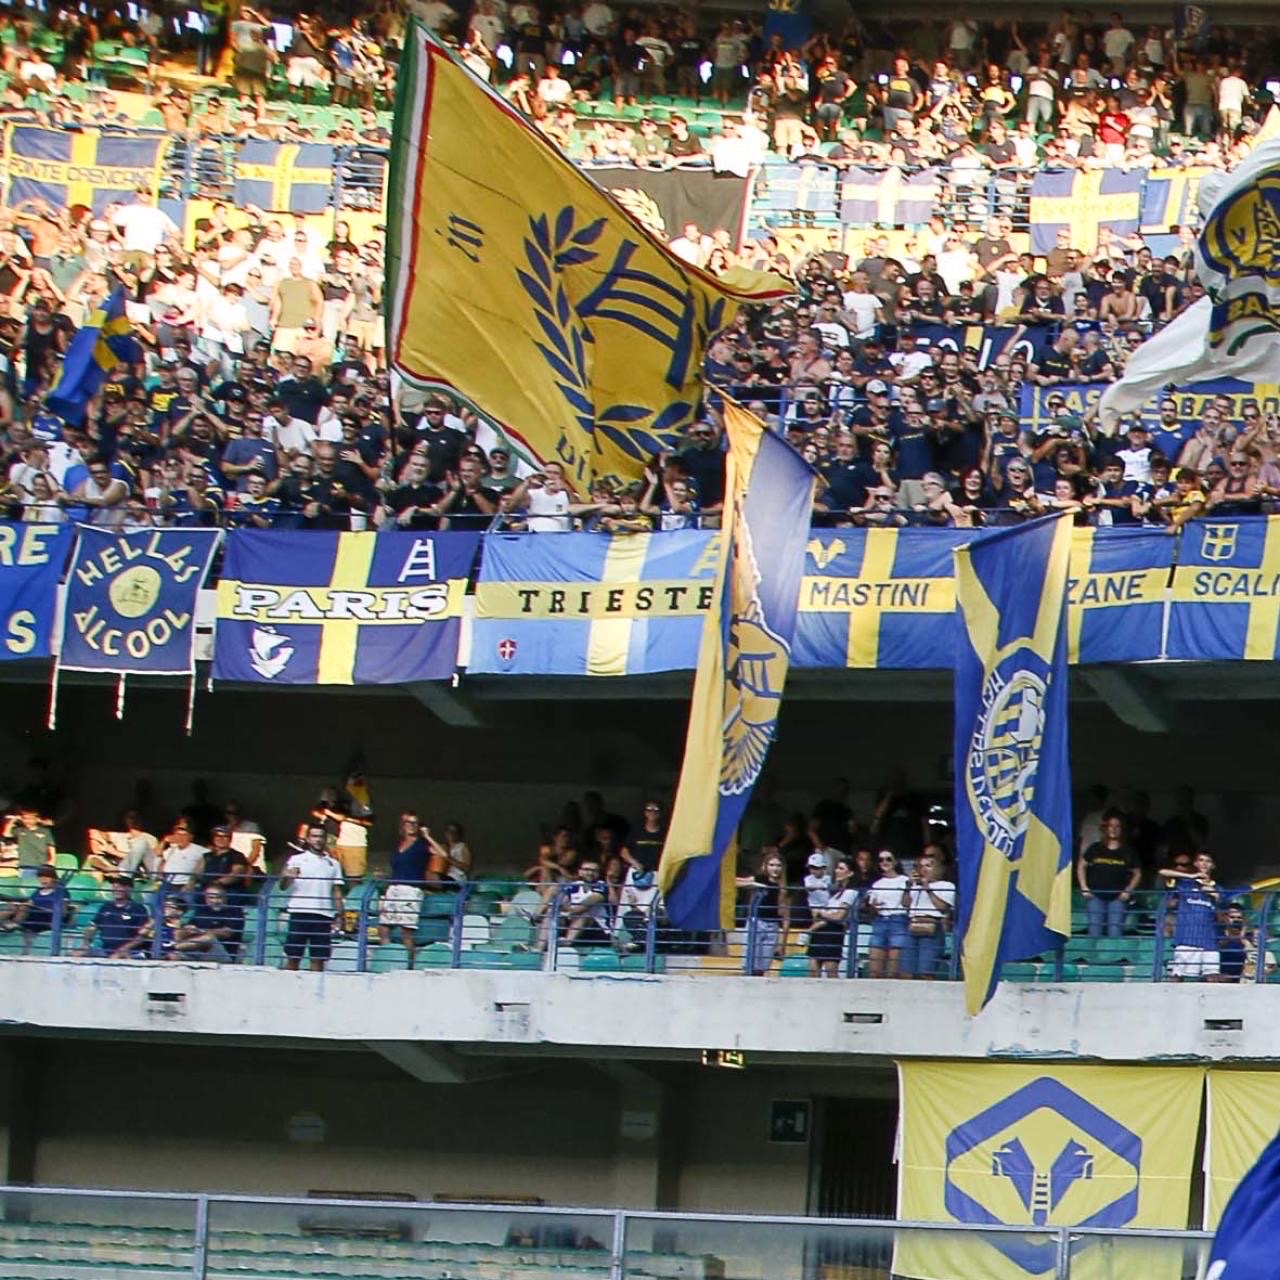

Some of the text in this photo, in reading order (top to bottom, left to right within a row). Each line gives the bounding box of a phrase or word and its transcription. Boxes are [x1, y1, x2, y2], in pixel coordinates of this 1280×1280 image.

[0, 524, 60, 567] RE
[76, 532, 199, 587] HELLAS
[233, 581, 450, 621] PARIS
[518, 586, 714, 614] TRIESTE
[809, 579, 930, 608] MASTINI
[5, 609, 37, 654] S
[73, 604, 191, 659] ALCOOL
